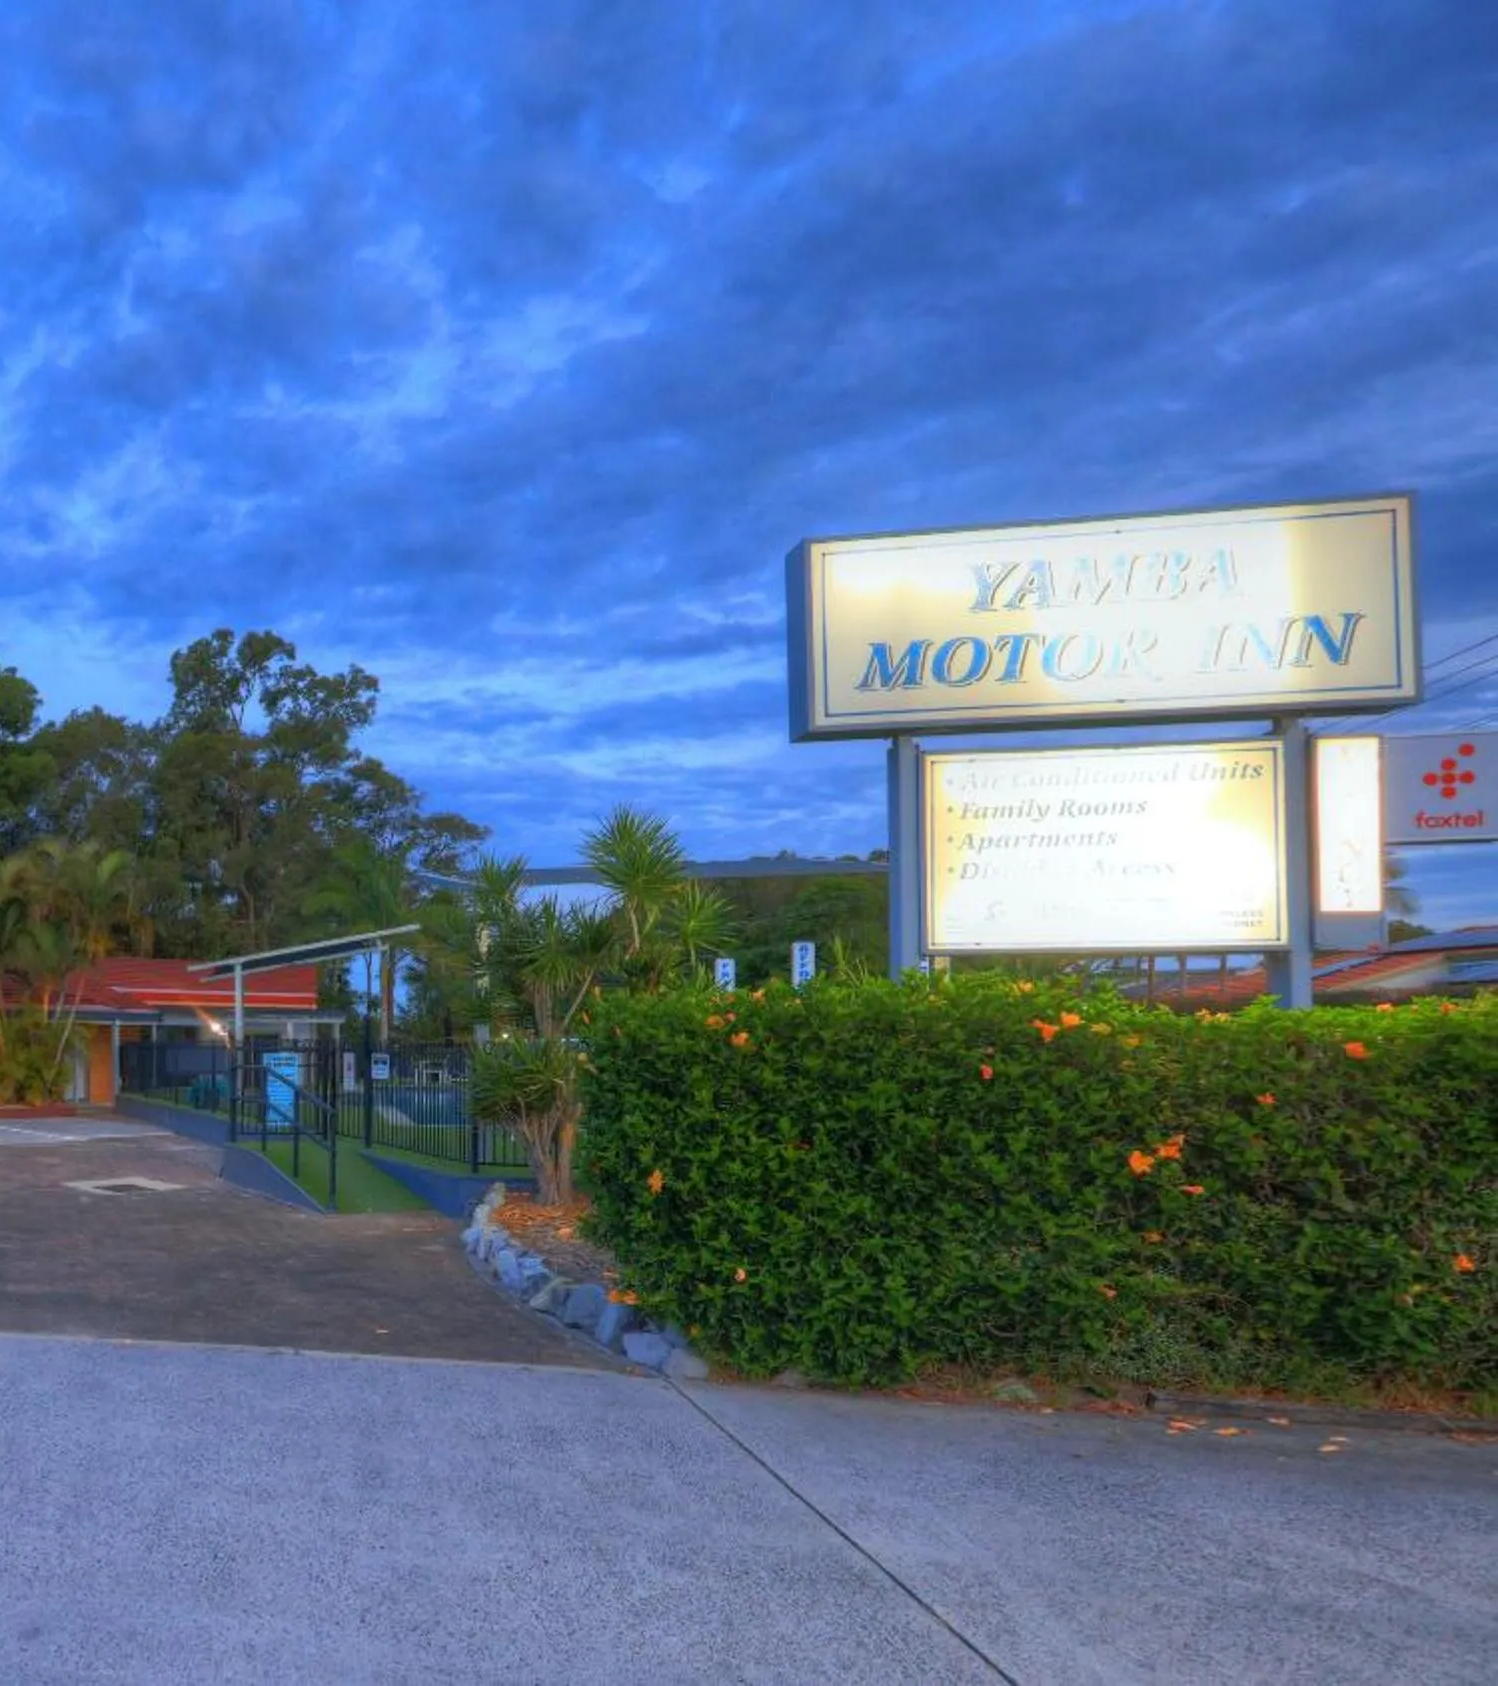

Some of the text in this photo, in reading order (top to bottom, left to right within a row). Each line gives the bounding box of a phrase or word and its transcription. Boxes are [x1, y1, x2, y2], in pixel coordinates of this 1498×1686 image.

[967, 544, 1248, 612] YAMBA
[854, 611, 1366, 693] MOTOR INN
[1188, 760, 1265, 781] Units
[959, 798, 1149, 823] Family Rooms
[1414, 808, 1485, 828] foxtel
[957, 829, 1118, 855] Apartments
